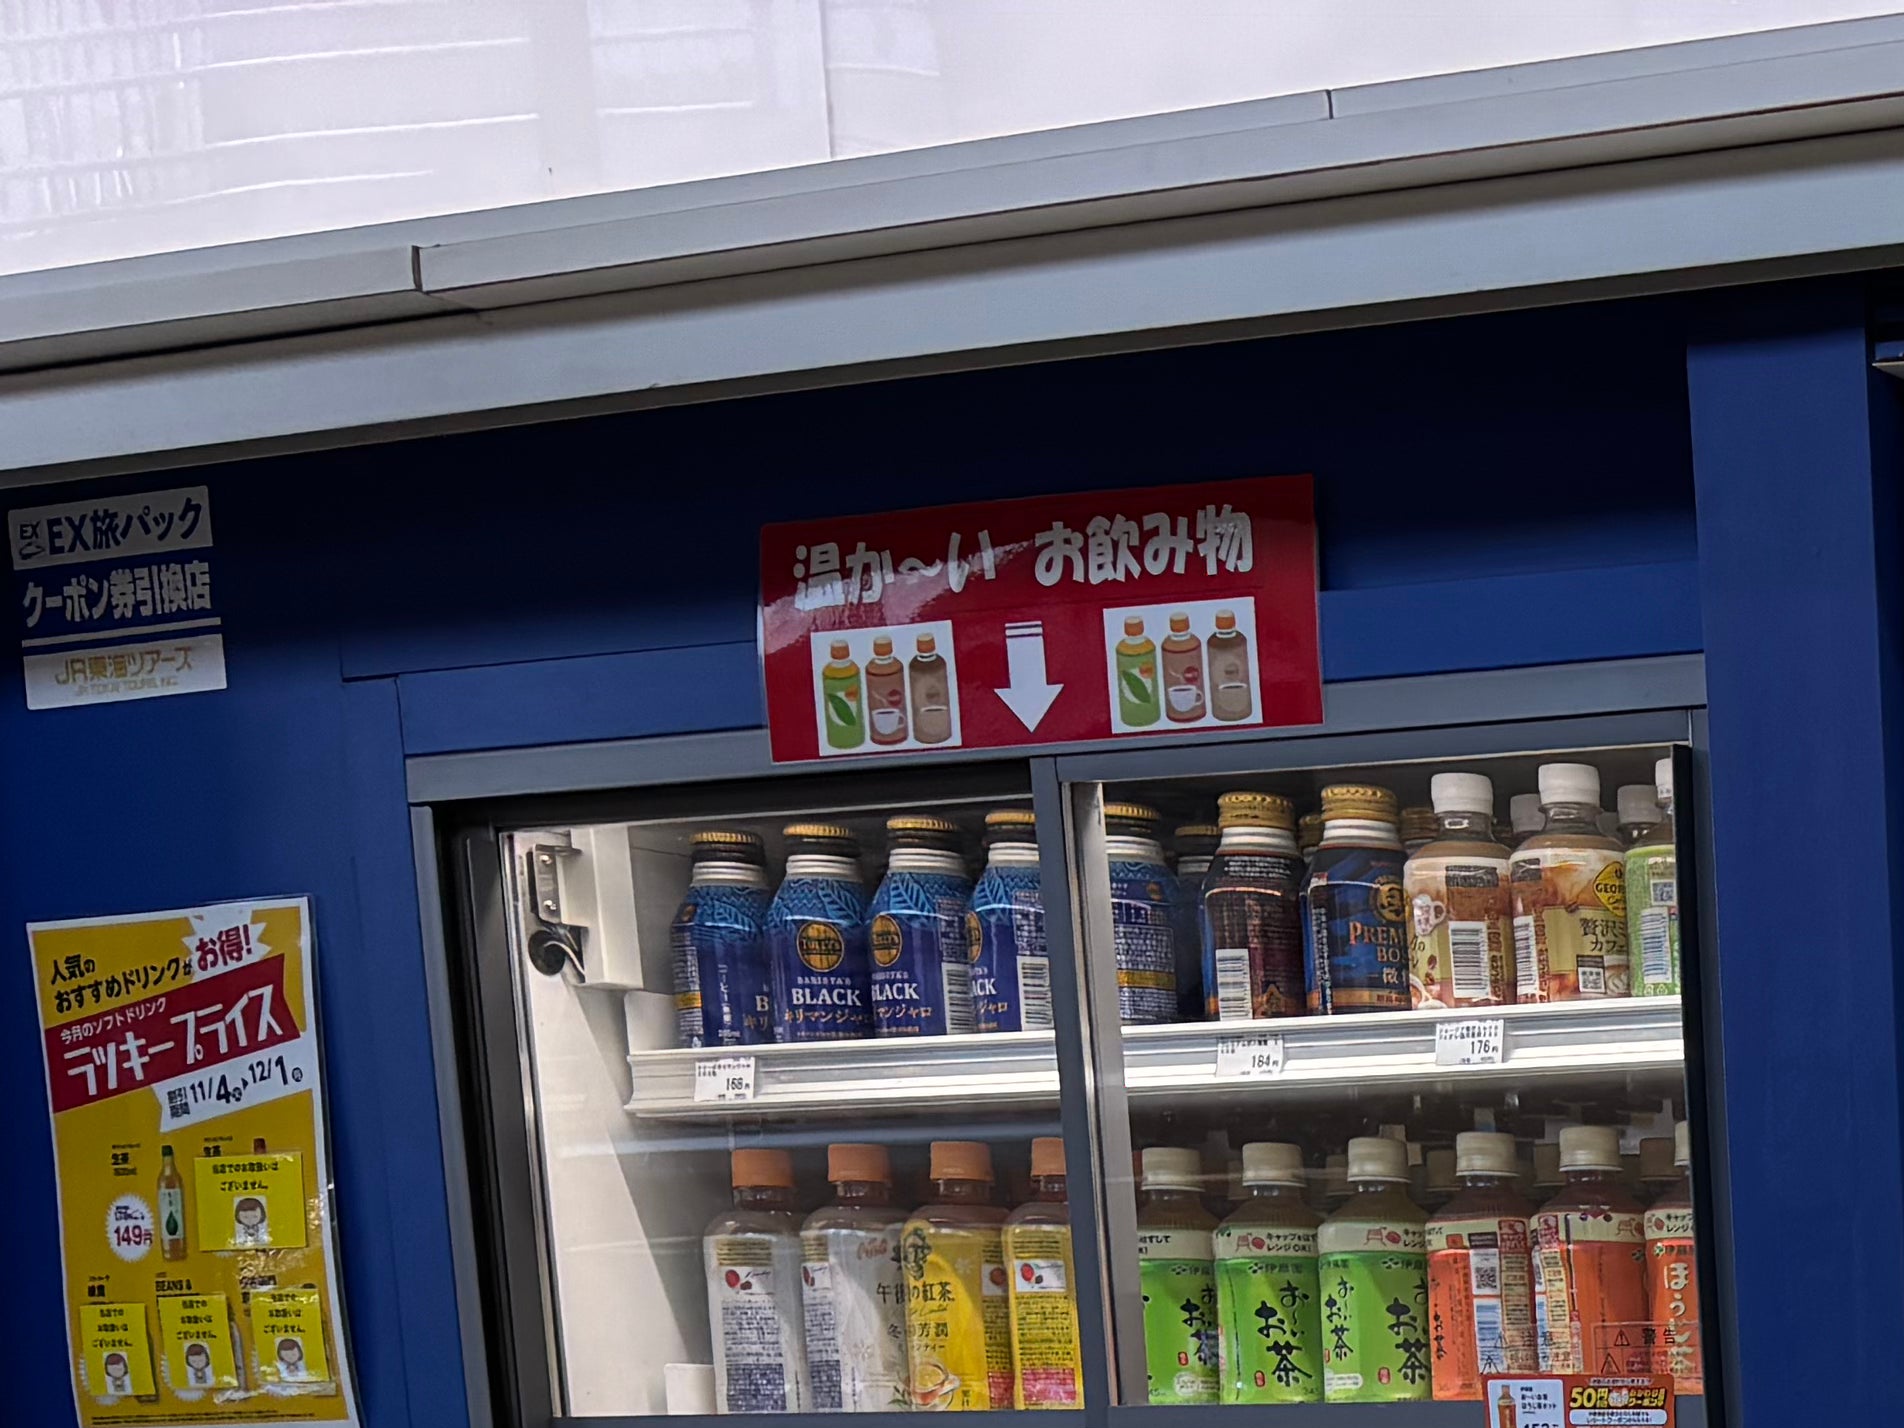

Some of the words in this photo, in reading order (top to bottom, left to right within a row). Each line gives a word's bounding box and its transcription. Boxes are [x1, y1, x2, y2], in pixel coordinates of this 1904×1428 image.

[46, 497, 203, 555] EX旅パック
[1034, 503, 1254, 586] お飲み物
[24, 559, 212, 629] クーポン券引換店
[55, 646, 193, 686] JR東海ツアーズ
[50, 953, 96, 985] 人気の
[53, 957, 193, 1014] おすすめドリンクが
[791, 987, 861, 1007] BLACK
[59, 996, 167, 1045] 今月のソフトドリンク
[63, 983, 284, 1096] ラッキープライス
